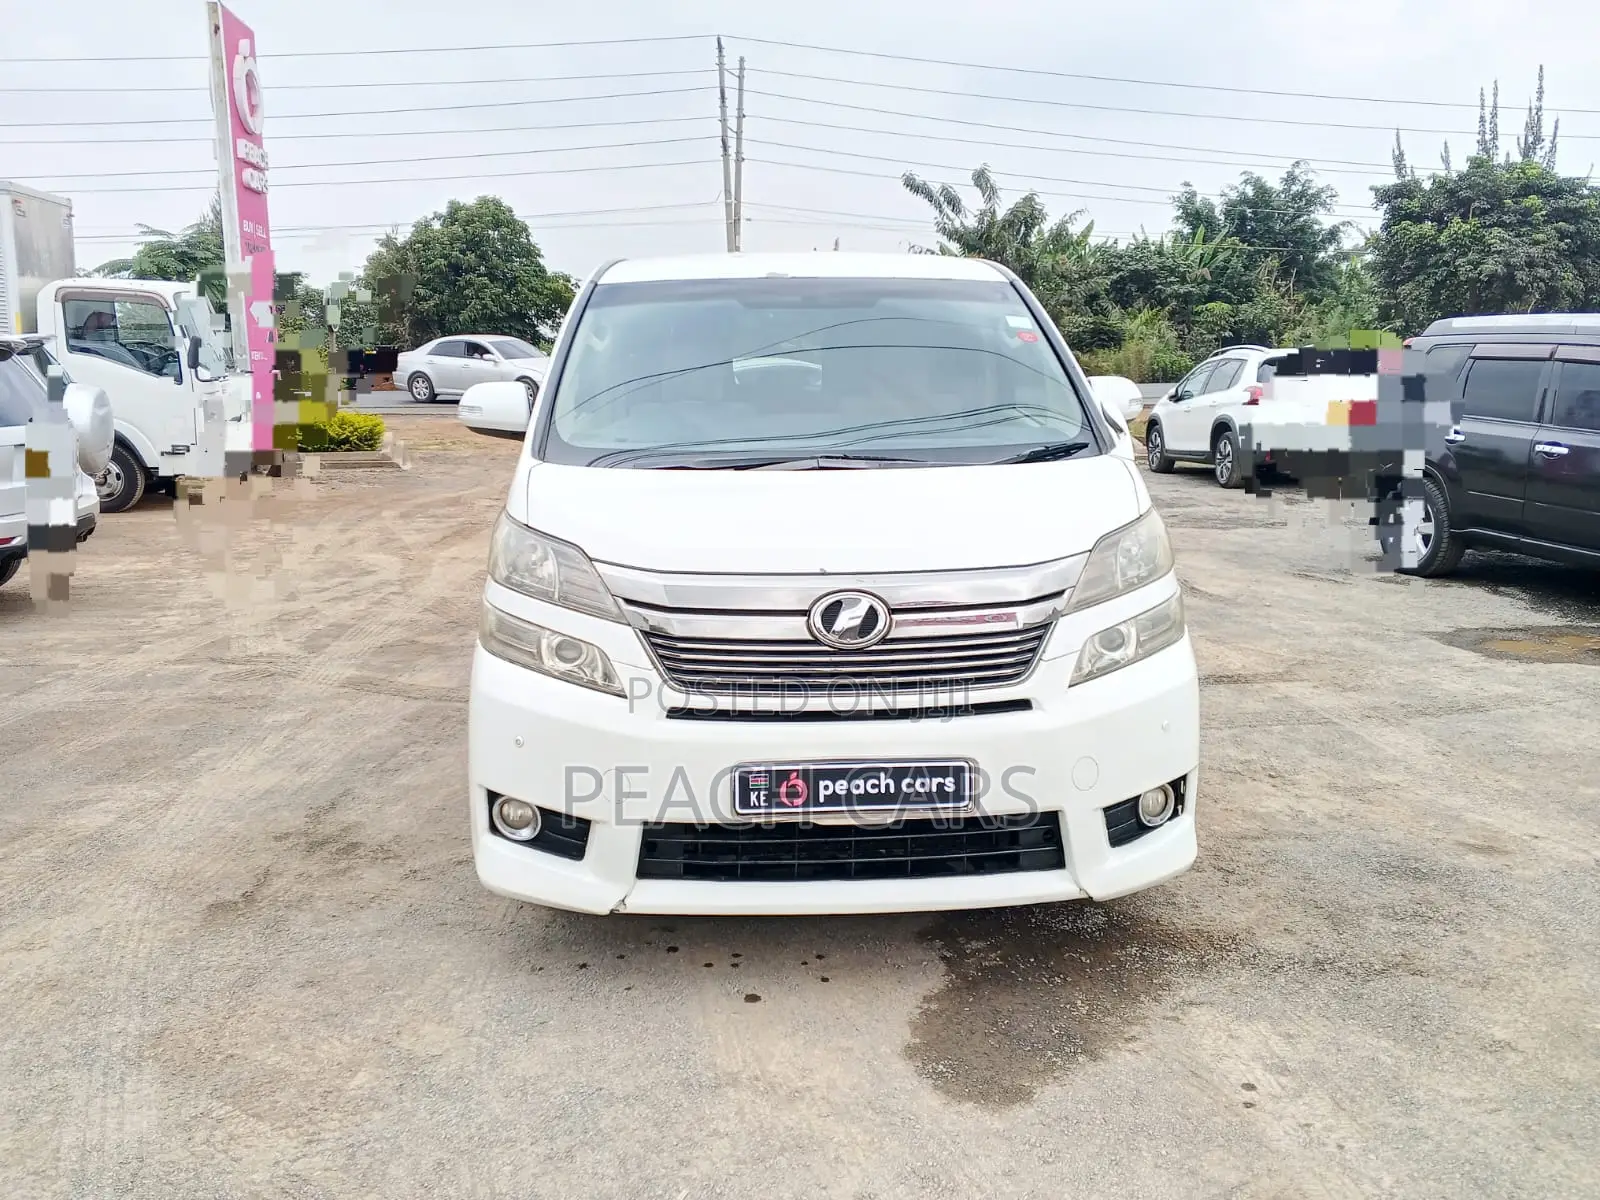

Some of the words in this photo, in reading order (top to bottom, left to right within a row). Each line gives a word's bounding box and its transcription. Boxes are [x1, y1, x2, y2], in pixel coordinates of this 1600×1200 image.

[750, 790, 769, 808] KE
[818, 772, 896, 804] peach
[901, 775, 957, 794] cars
